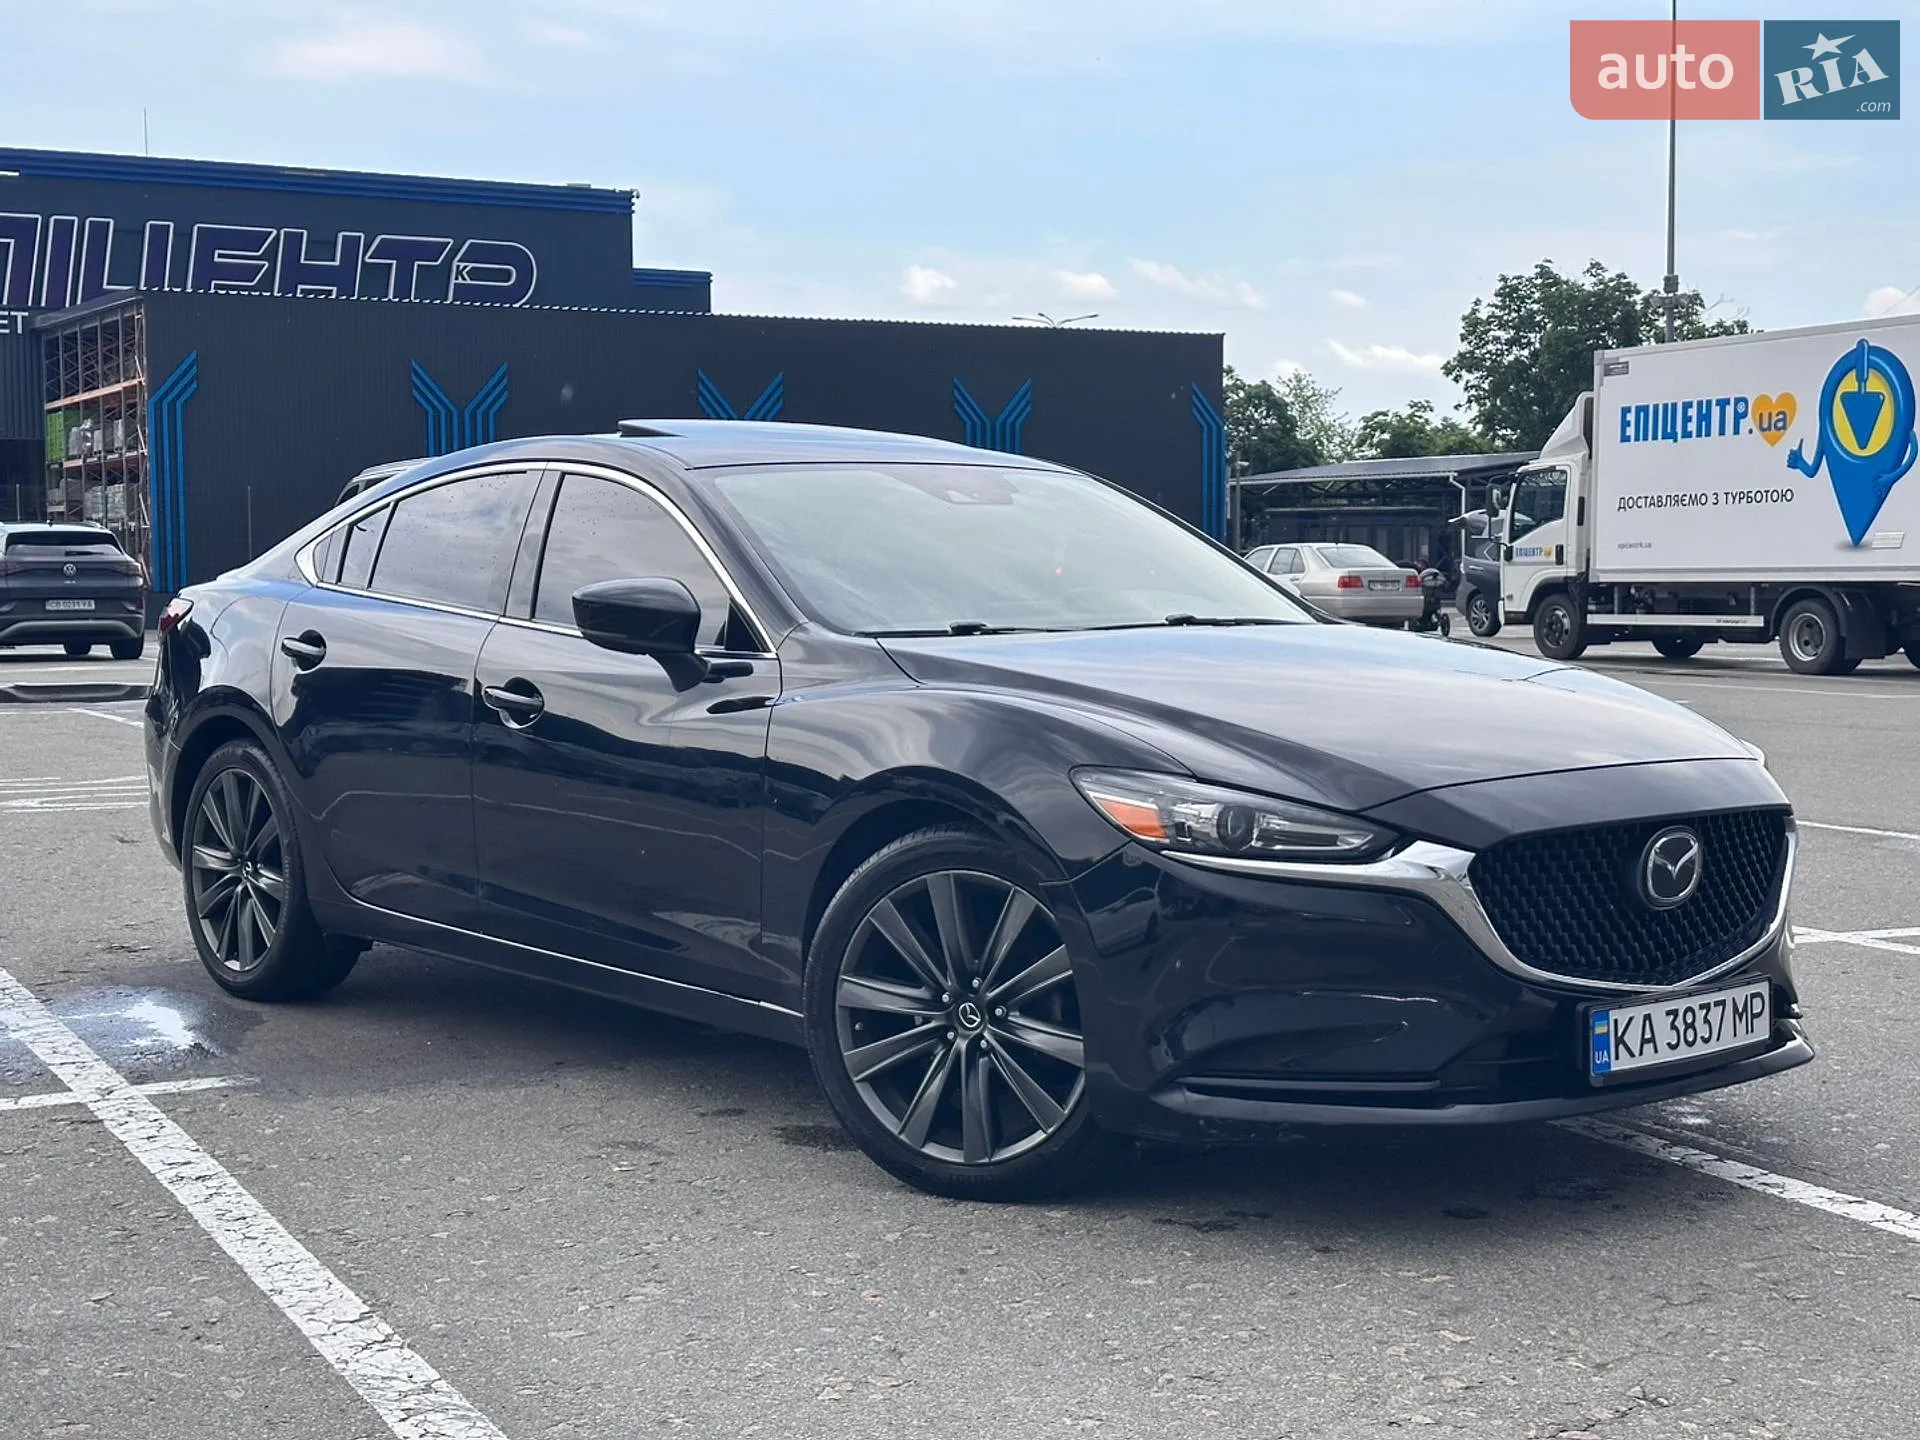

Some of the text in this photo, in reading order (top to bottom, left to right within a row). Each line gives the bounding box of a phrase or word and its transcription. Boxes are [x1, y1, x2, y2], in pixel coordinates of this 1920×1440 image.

[1617, 492, 1708, 512] ДОСТАВЛЯЄМО
[1723, 488, 1795, 505] ТУРБОТОЮ
[1613, 991, 1765, 1061] KA 3837 MP
[1595, 1050, 1609, 1065] UA
